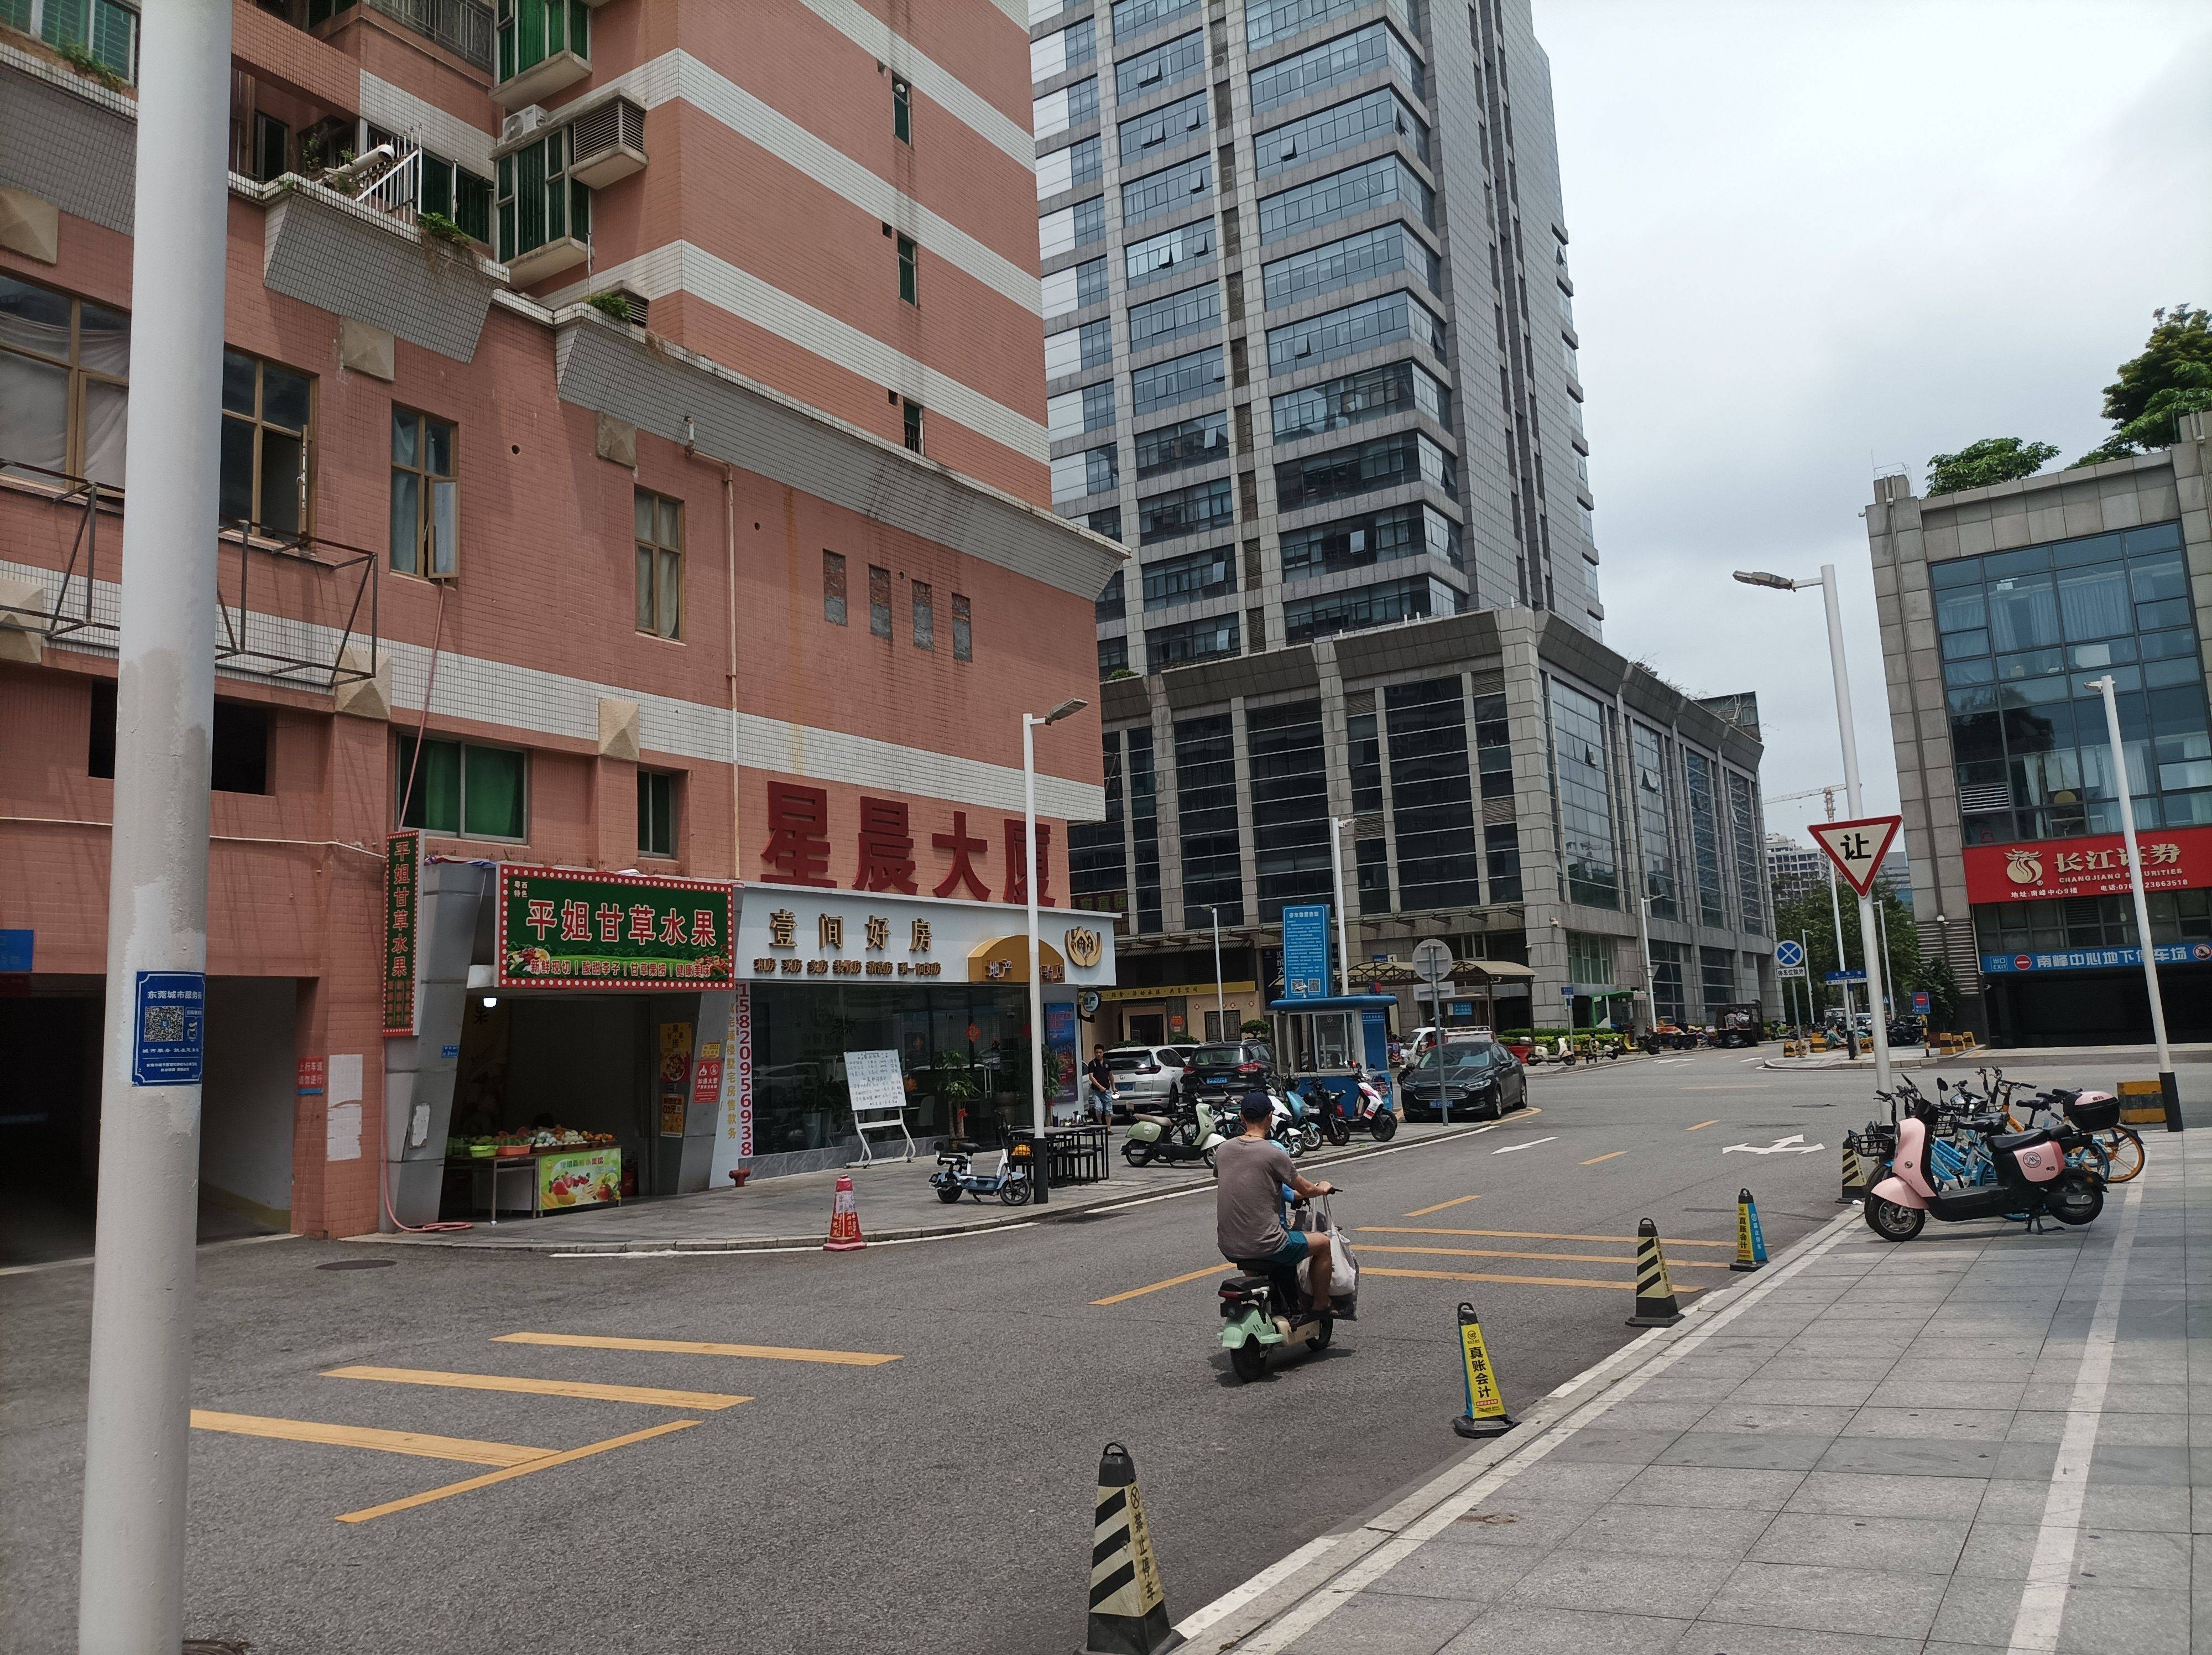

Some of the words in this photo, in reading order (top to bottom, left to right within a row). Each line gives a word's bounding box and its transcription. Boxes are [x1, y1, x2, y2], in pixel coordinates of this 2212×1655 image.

[760, 780, 1056, 907] 星晨大厦
[1840, 833, 1871, 861] 让
[2054, 844, 2181, 873] 长江证券
[2059, 872, 2121, 883] CHANGJIANG
[2125, 868, 2183, 879] SURITIES
[2100, 879, 2188, 892] 电话:07623663518
[514, 889, 528, 898] 特色
[2011, 887, 2078, 898] 地址:南峰中心9楼
[391, 841, 410, 977] 平姐甘草水果
[526, 898, 717, 946] 平姐甘草水果
[769, 908, 933, 952] 壹间好房
[985, 958, 1013, 979] 地产
[1040, 964, 1065, 980] 验店
[298, 1074, 323, 1085] 请勿逆行
[739, 983, 753, 1157] 15820956938
[1469, 1346, 1491, 1398] 真账会计
[1134, 1512, 1156, 1601] 禁止停车
